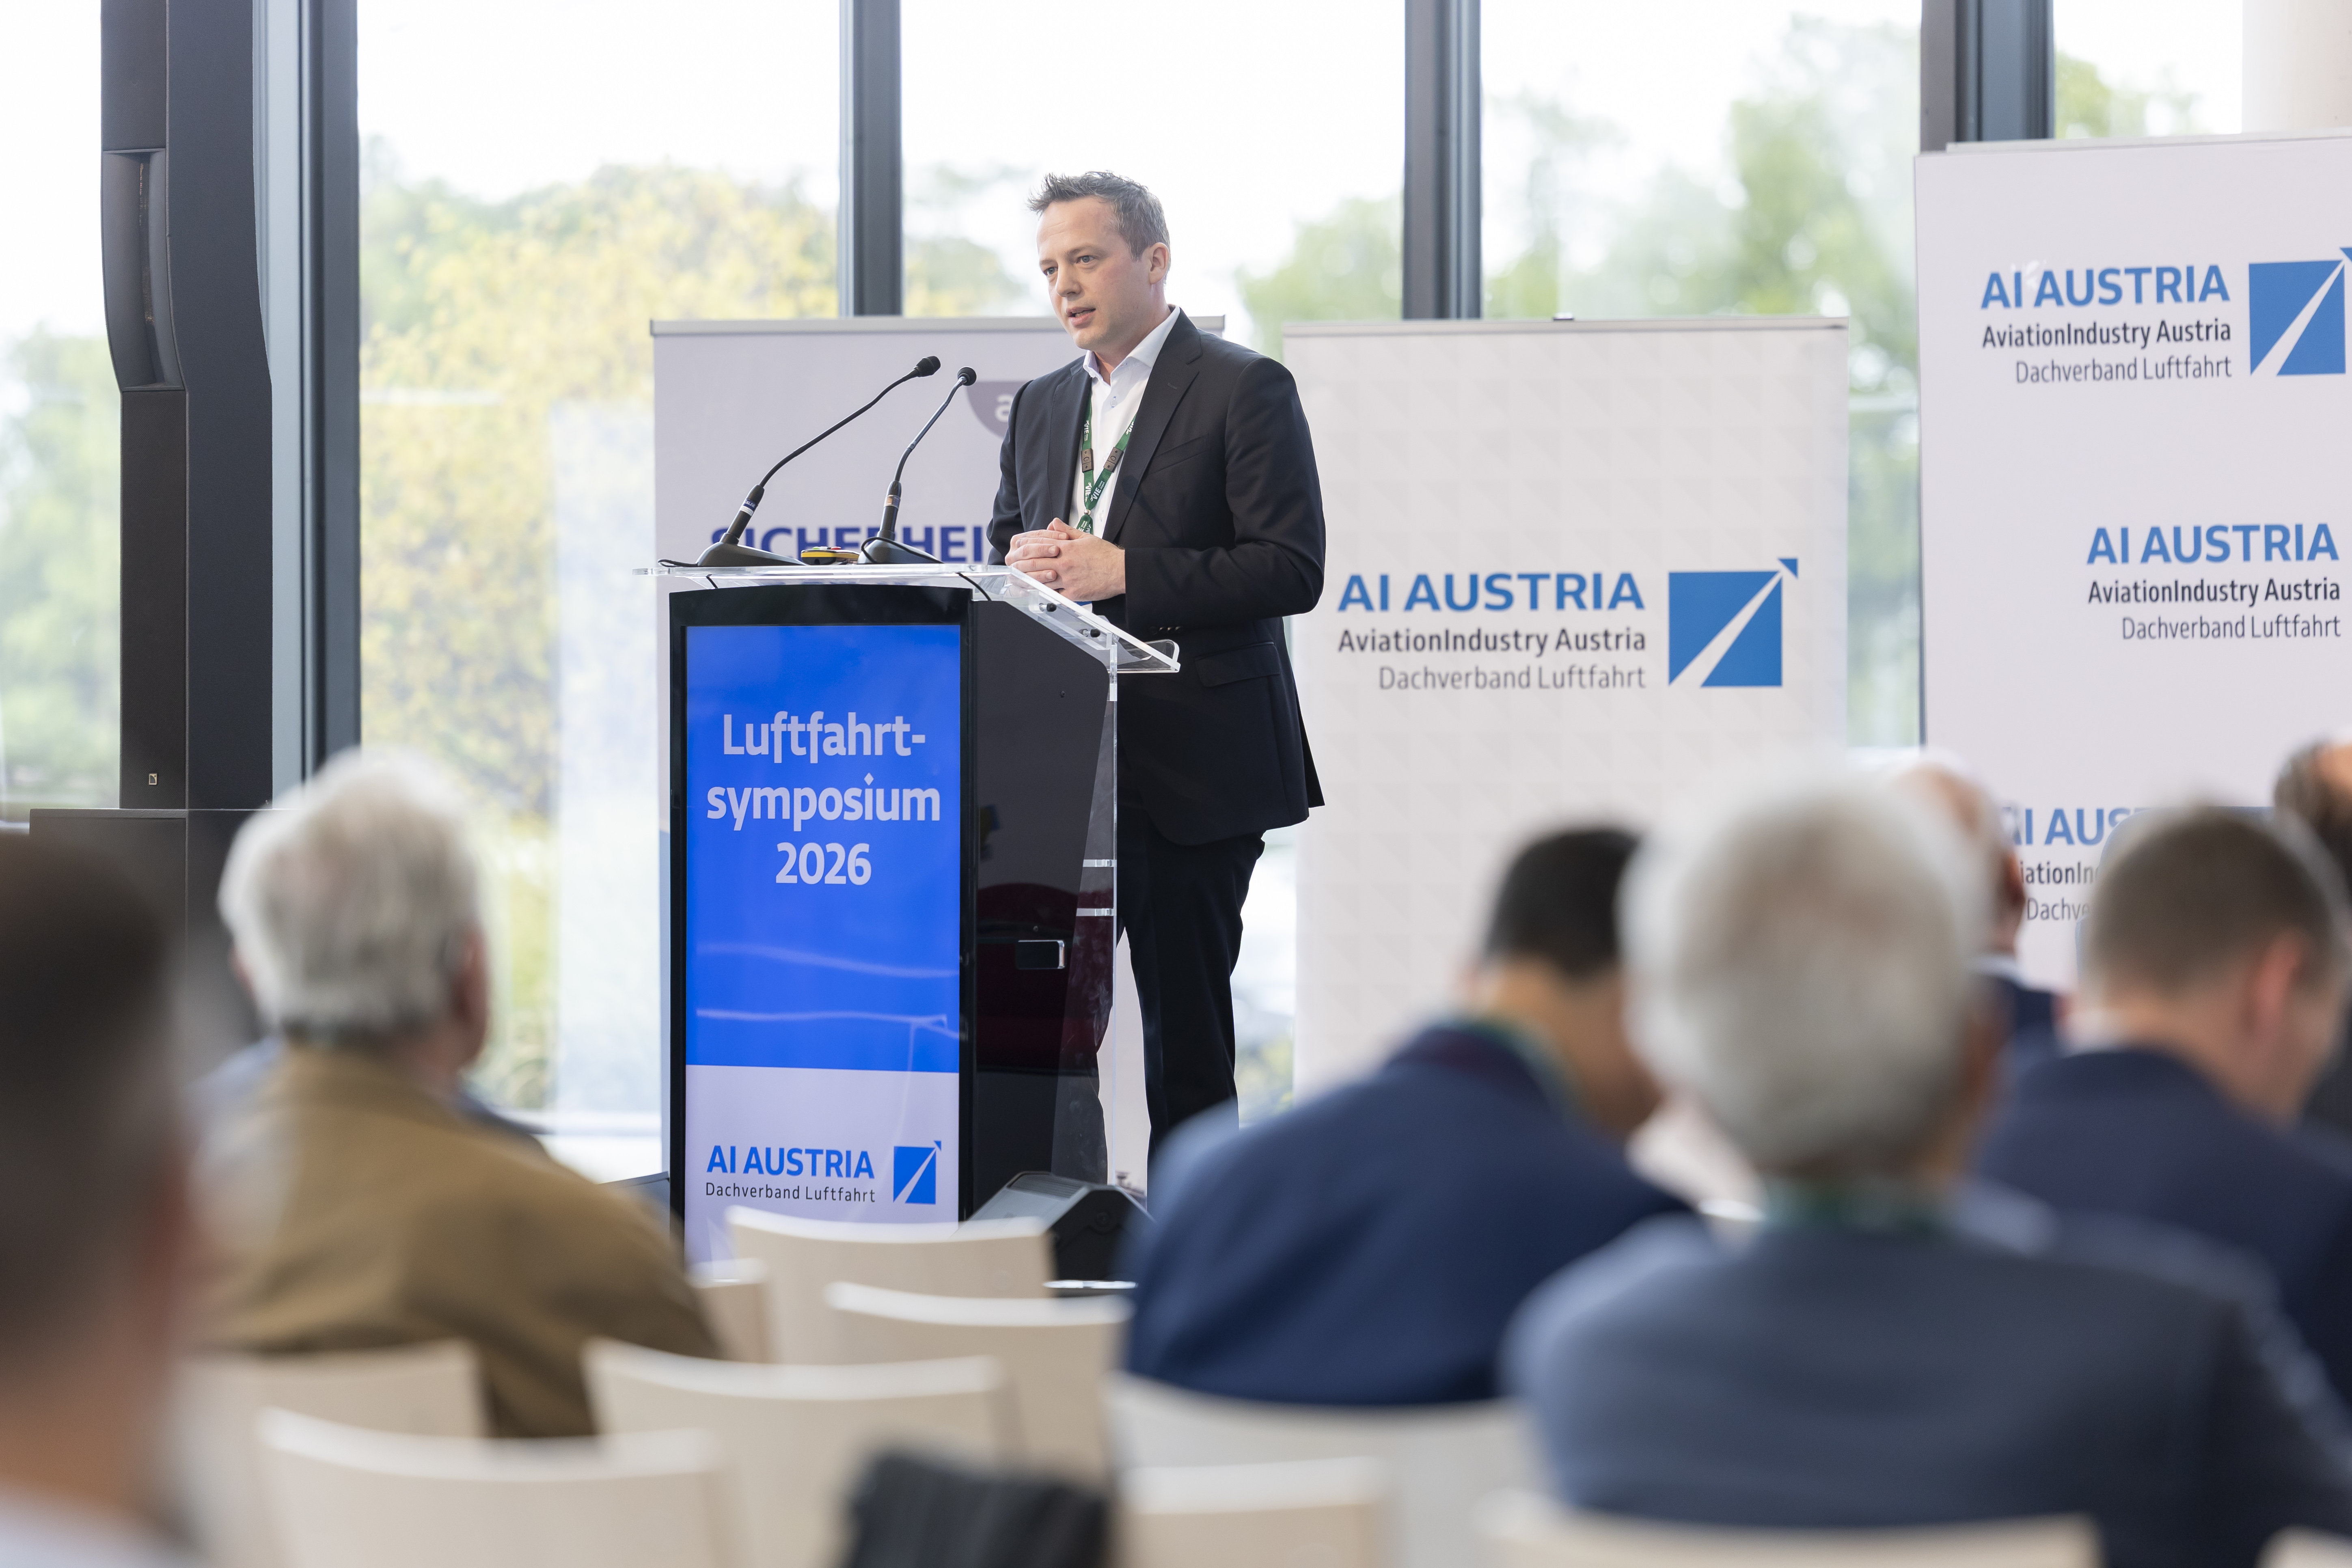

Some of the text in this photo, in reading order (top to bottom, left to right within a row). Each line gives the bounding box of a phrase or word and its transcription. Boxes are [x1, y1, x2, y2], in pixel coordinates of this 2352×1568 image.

[1981, 265, 2230, 309] AI AUSTRIA
[1983, 318, 2231, 349] AviationIndustry Austria
[2016, 355, 2232, 384] Dachverband Luftfahrt
[1092, 487, 1101, 500] VIE
[2087, 523, 2339, 564] AI AUSTRIA
[1338, 572, 1645, 612] AI AUSTRIA
[2088, 577, 2340, 608] AviationIndustry Austria
[1338, 627, 1646, 658] AviationIndustry Austria
[2122, 614, 2341, 640] Dachverband Luftfahrt
[1379, 664, 1646, 690] Dachverband Luftfahrt
[724, 711, 926, 764] Luftfahrt-
[707, 772, 940, 831] symposium
[775, 842, 872, 885] 2026
[707, 1145, 875, 1179] AI AUSTRIA
[706, 1182, 875, 1203] Dachverband Luftfahrt
